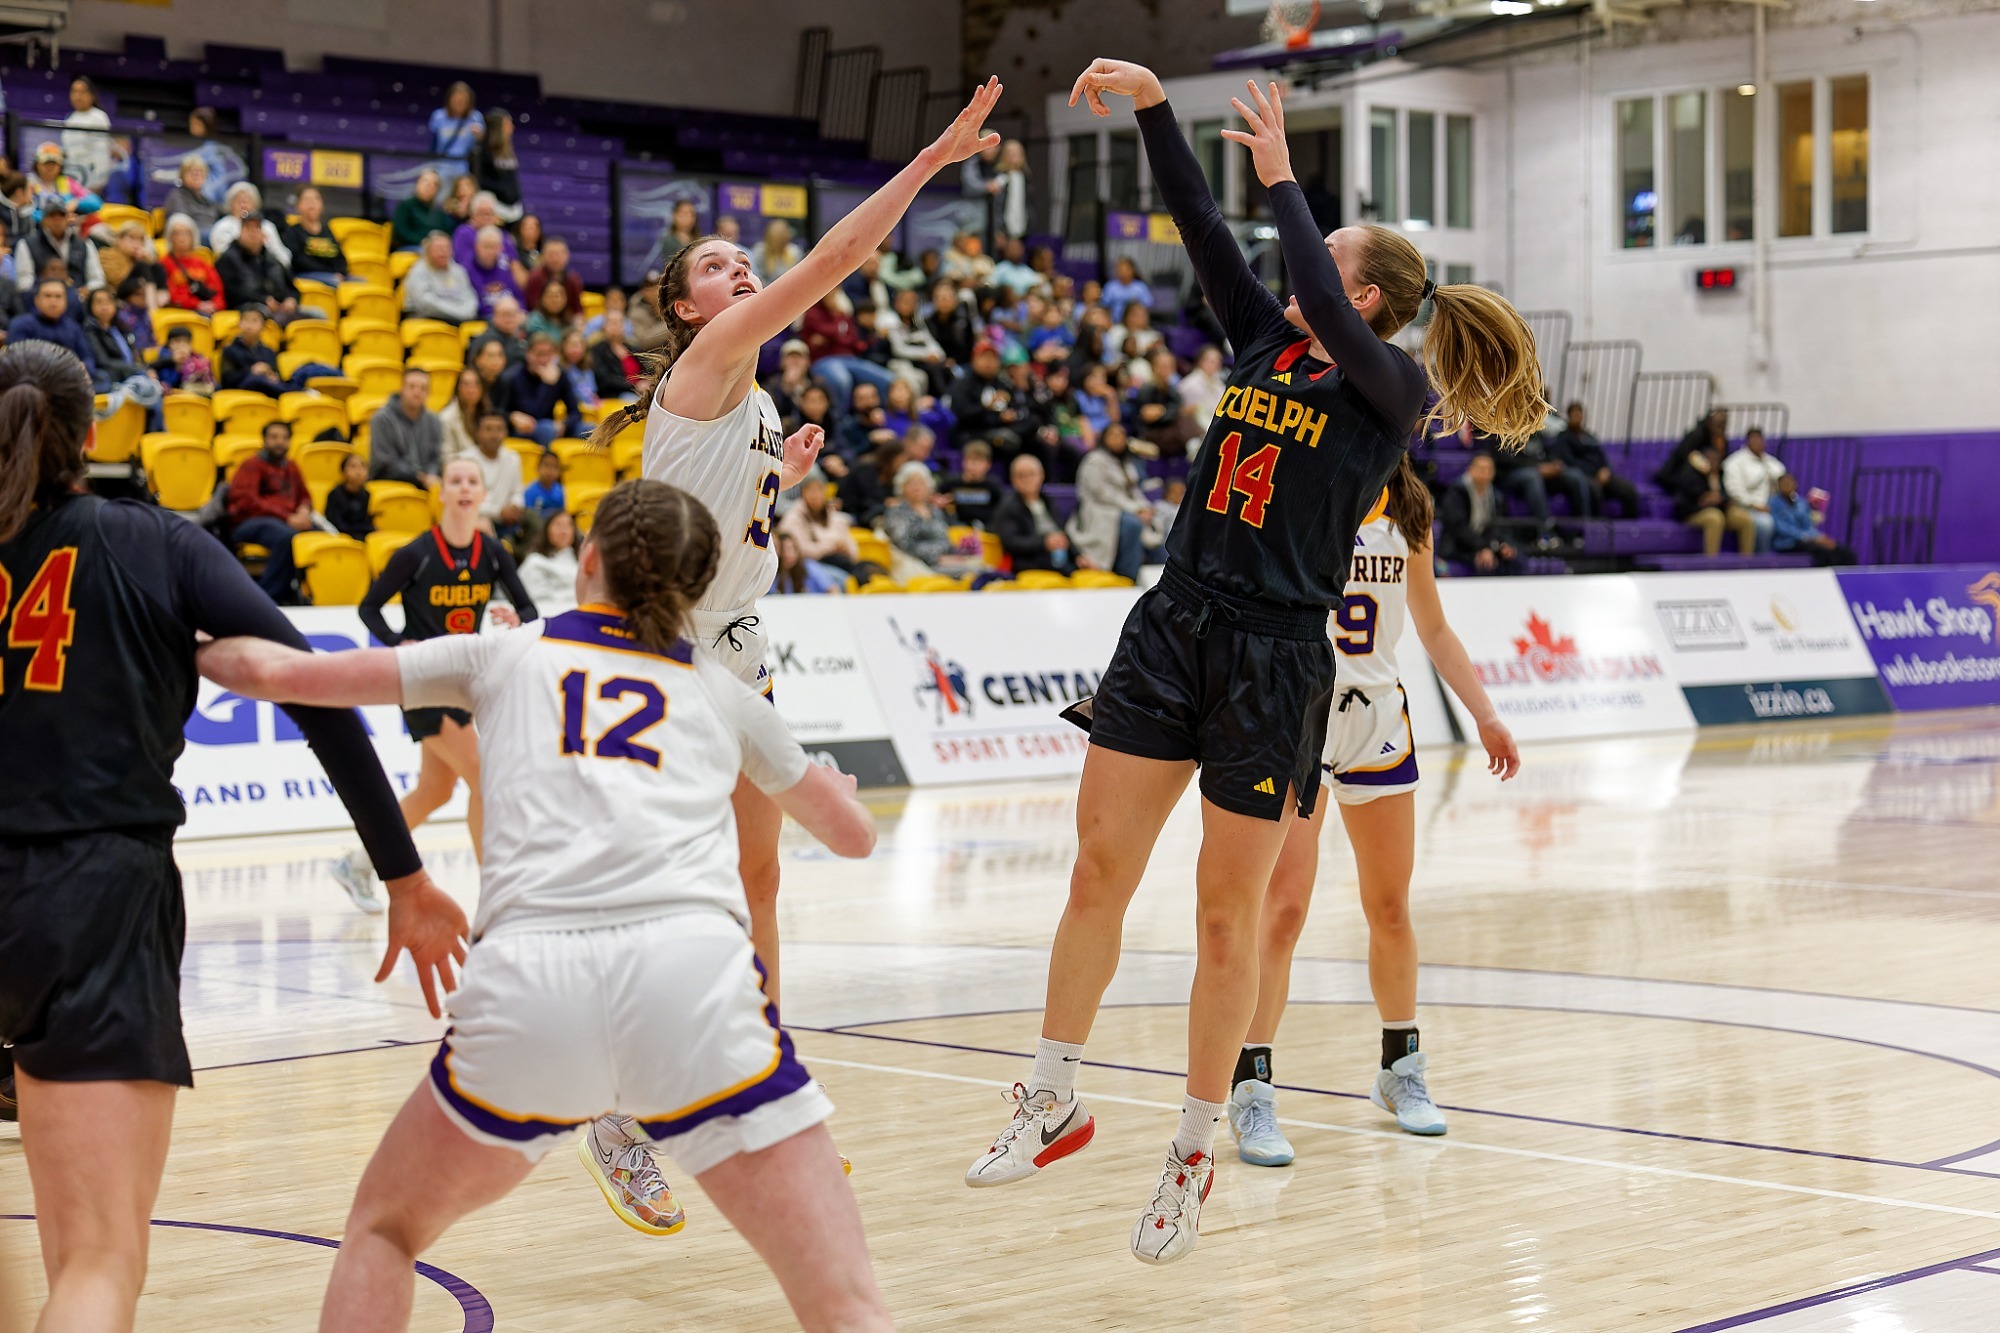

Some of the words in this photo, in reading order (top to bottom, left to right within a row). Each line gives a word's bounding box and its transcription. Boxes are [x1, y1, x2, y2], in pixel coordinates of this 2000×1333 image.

[1206, 431, 1282, 529] 14
[1347, 554, 1405, 583] RIER
[429, 583, 491, 607] GUELPH
[0, 546, 79, 692] 4
[1334, 592, 1379, 656] 9
[1852, 597, 1934, 640] Hawk
[1926, 596, 1993, 645] Shop
[983, 670, 1104, 706] CENTA
[1473, 657, 1532, 686] REAT
[1745, 683, 1835, 718] izzio.ca
[559, 668, 669, 772] 12
[934, 736, 1009, 765] SPORT
[284, 773, 337, 800] RIV
